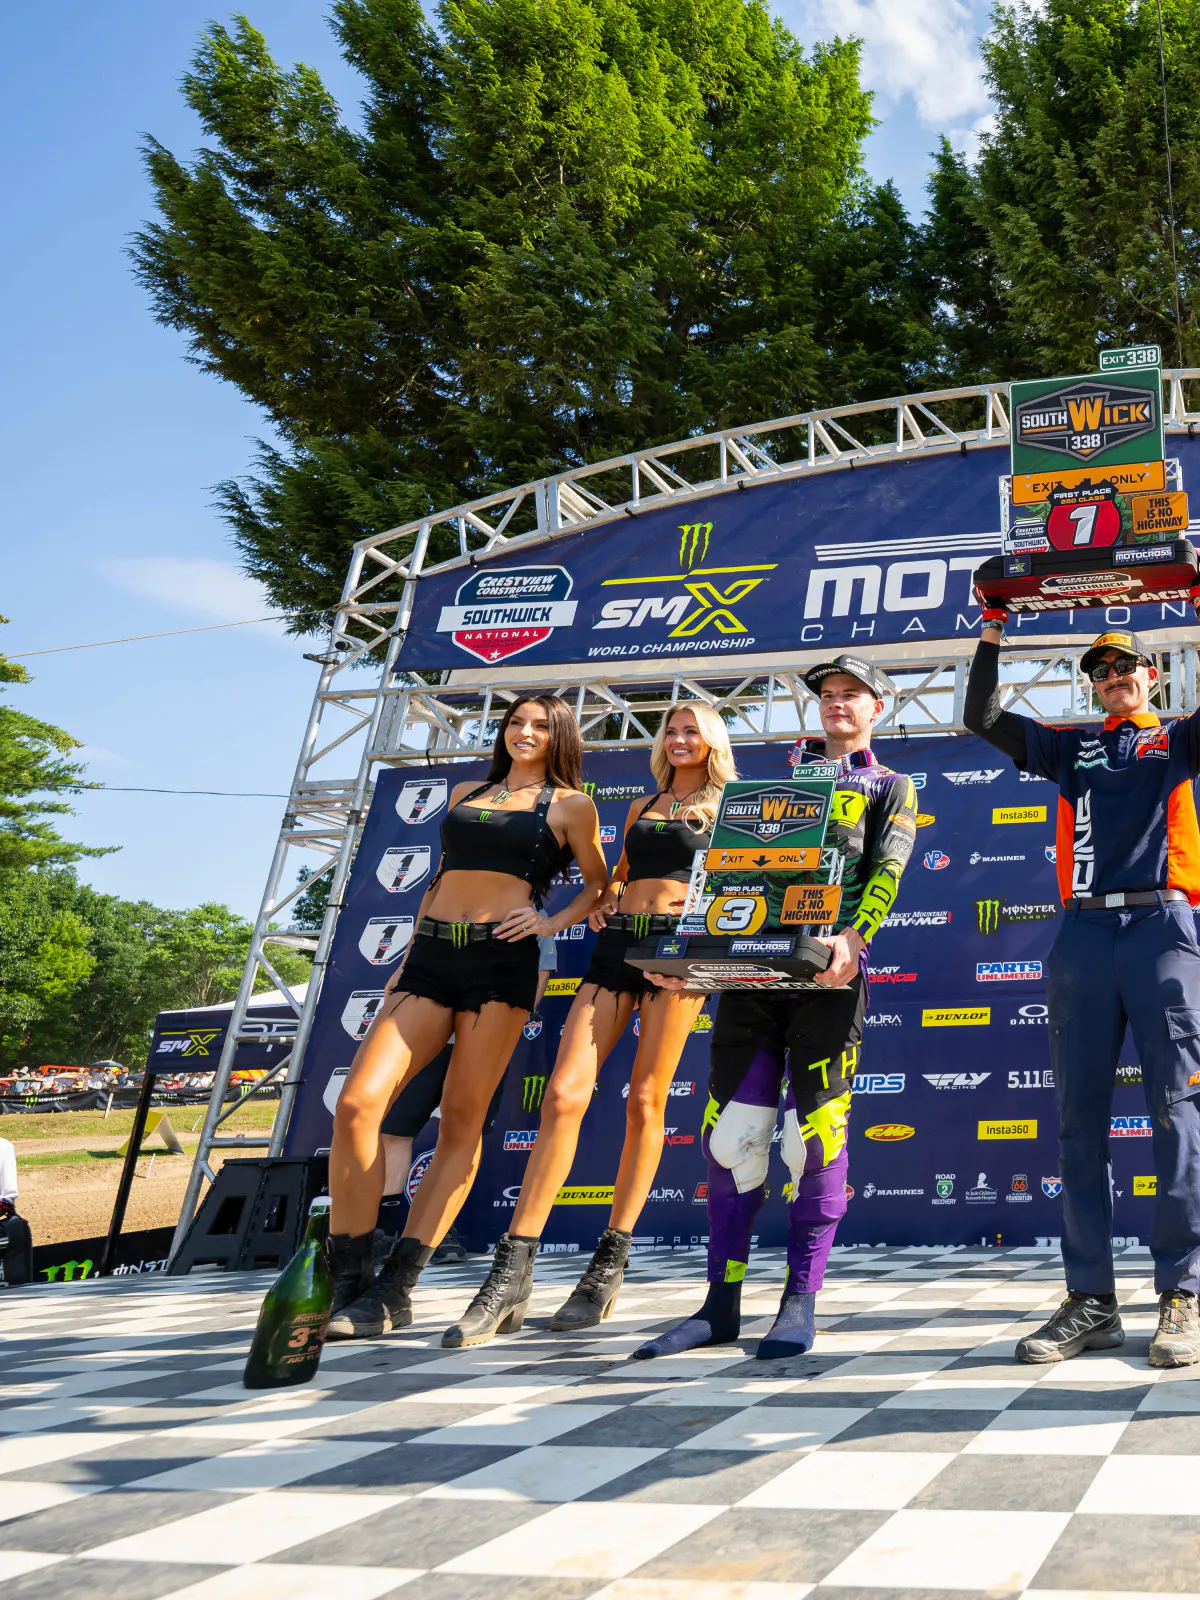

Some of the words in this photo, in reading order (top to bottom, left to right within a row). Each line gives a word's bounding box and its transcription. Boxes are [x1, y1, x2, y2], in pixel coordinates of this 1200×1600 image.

[1102, 354, 1125, 365] EXIT
[1126, 349, 1157, 365] 338
[1071, 434, 1100, 450] 338
[1032, 481, 1063, 493] EXIT
[1109, 473, 1147, 485] ONLY
[1053, 490, 1079, 500] FIRST
[1082, 487, 1112, 497] PLACE
[1078, 495, 1105, 503] CLASS
[1148, 497, 1169, 508] THIS
[1146, 509, 1156, 519] IS
[1158, 508, 1173, 518] NO
[1068, 504, 1098, 546] 1
[1136, 516, 1183, 530] HIGHWAY
[1013, 539, 1047, 548] SOUTHWICK
[1115, 548, 1173, 560] MOTOCROSS
[478, 575, 557, 588] CRESTVIEW
[1058, 581, 1125, 592] SOUTHWICK
[476, 584, 554, 596] CONSTRUCTION
[592, 578, 764, 637] SMX
[1006, 597, 1092, 612] FIRST
[461, 607, 553, 625] SOUTHWICK
[464, 630, 538, 640] NATIONAL
[588, 644, 639, 657] WORLD
[642, 637, 755, 654] CHAMPIONSHIP
[813, 766, 835, 777] 338
[942, 768, 1006, 783] FLY
[597, 785, 645, 796] MONSTER
[1000, 811, 1039, 820] Insta360
[758, 823, 780, 834] 338
[721, 855, 744, 863] EXIT
[778, 855, 807, 863] ONLY
[802, 889, 824, 899] THIS
[797, 900, 806, 909] IS
[808, 900, 824, 909] NO
[1002, 904, 1056, 914] MONSTER
[716, 898, 756, 931] 3
[783, 911, 833, 921] HIGHWAY
[912, 910, 947, 918] MOUNTAIN
[977, 961, 1041, 974] PARTS
[977, 972, 1041, 981] UNLIMITED
[935, 1012, 988, 1021] DUNLOP
[156, 1034, 217, 1056] SMX
[922, 1072, 992, 1087] FLY
[1007, 1070, 1042, 1089] 5.11
[865, 1125, 916, 1139] FMF
[986, 1125, 1028, 1135] Insta360
[941, 1185, 948, 1195] 2
[1013, 1180, 1026, 1190] 66
[1047, 1183, 1057, 1194] X
[562, 1191, 614, 1199] DUNLOP
[877, 1188, 924, 1196] MARINES
